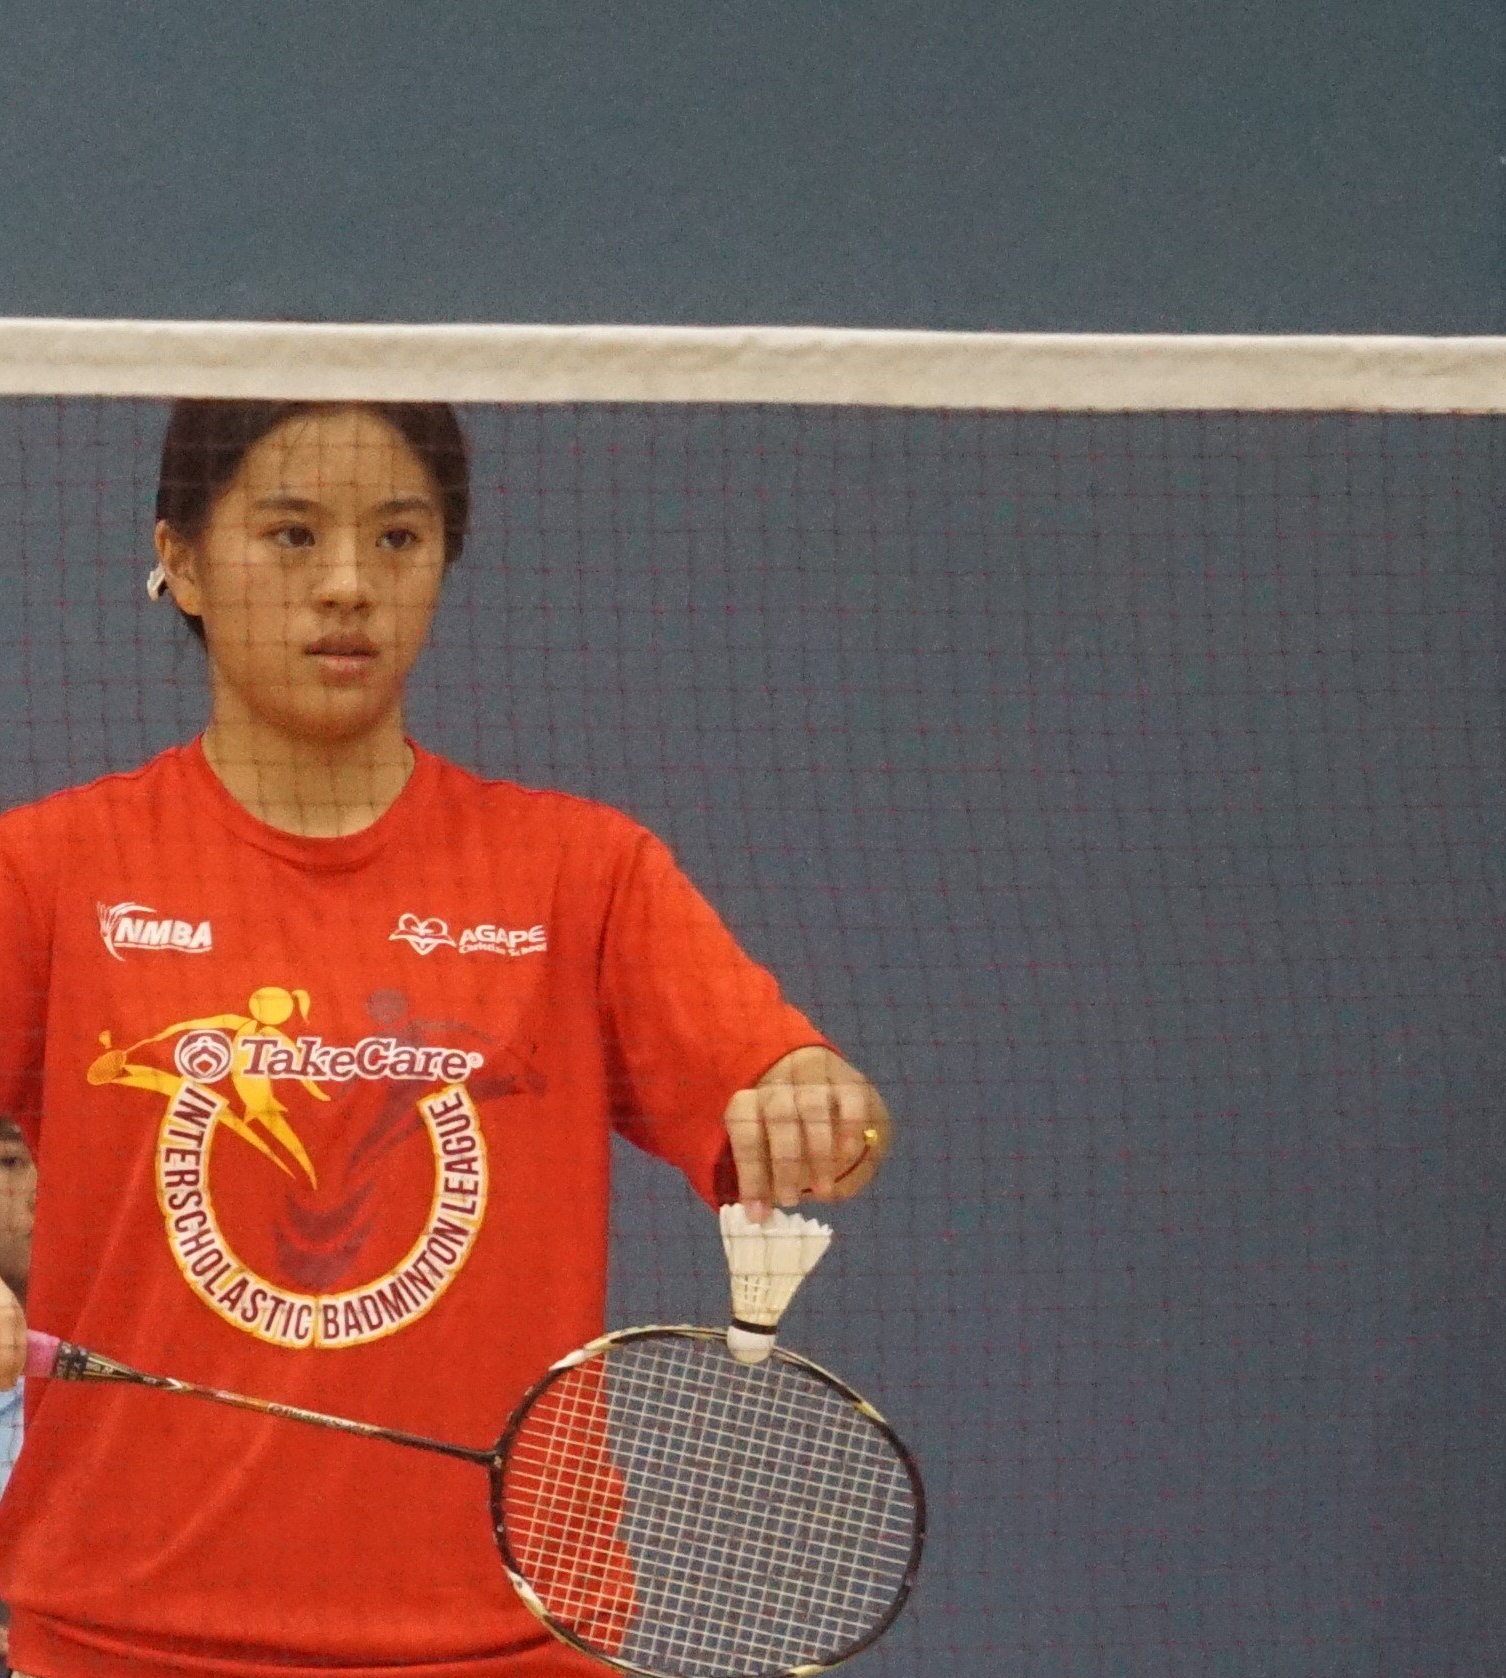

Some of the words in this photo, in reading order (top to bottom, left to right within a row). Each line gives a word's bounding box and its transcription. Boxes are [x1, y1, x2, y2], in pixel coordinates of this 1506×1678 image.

[113, 916, 213, 949] NMBA
[459, 924, 547, 948] AGAPE
[164, 1086, 311, 1341] INTERSCHOLASTIC
[322, 1215, 470, 1340] BADMINTON
[426, 1091, 481, 1216] LEAGUE
